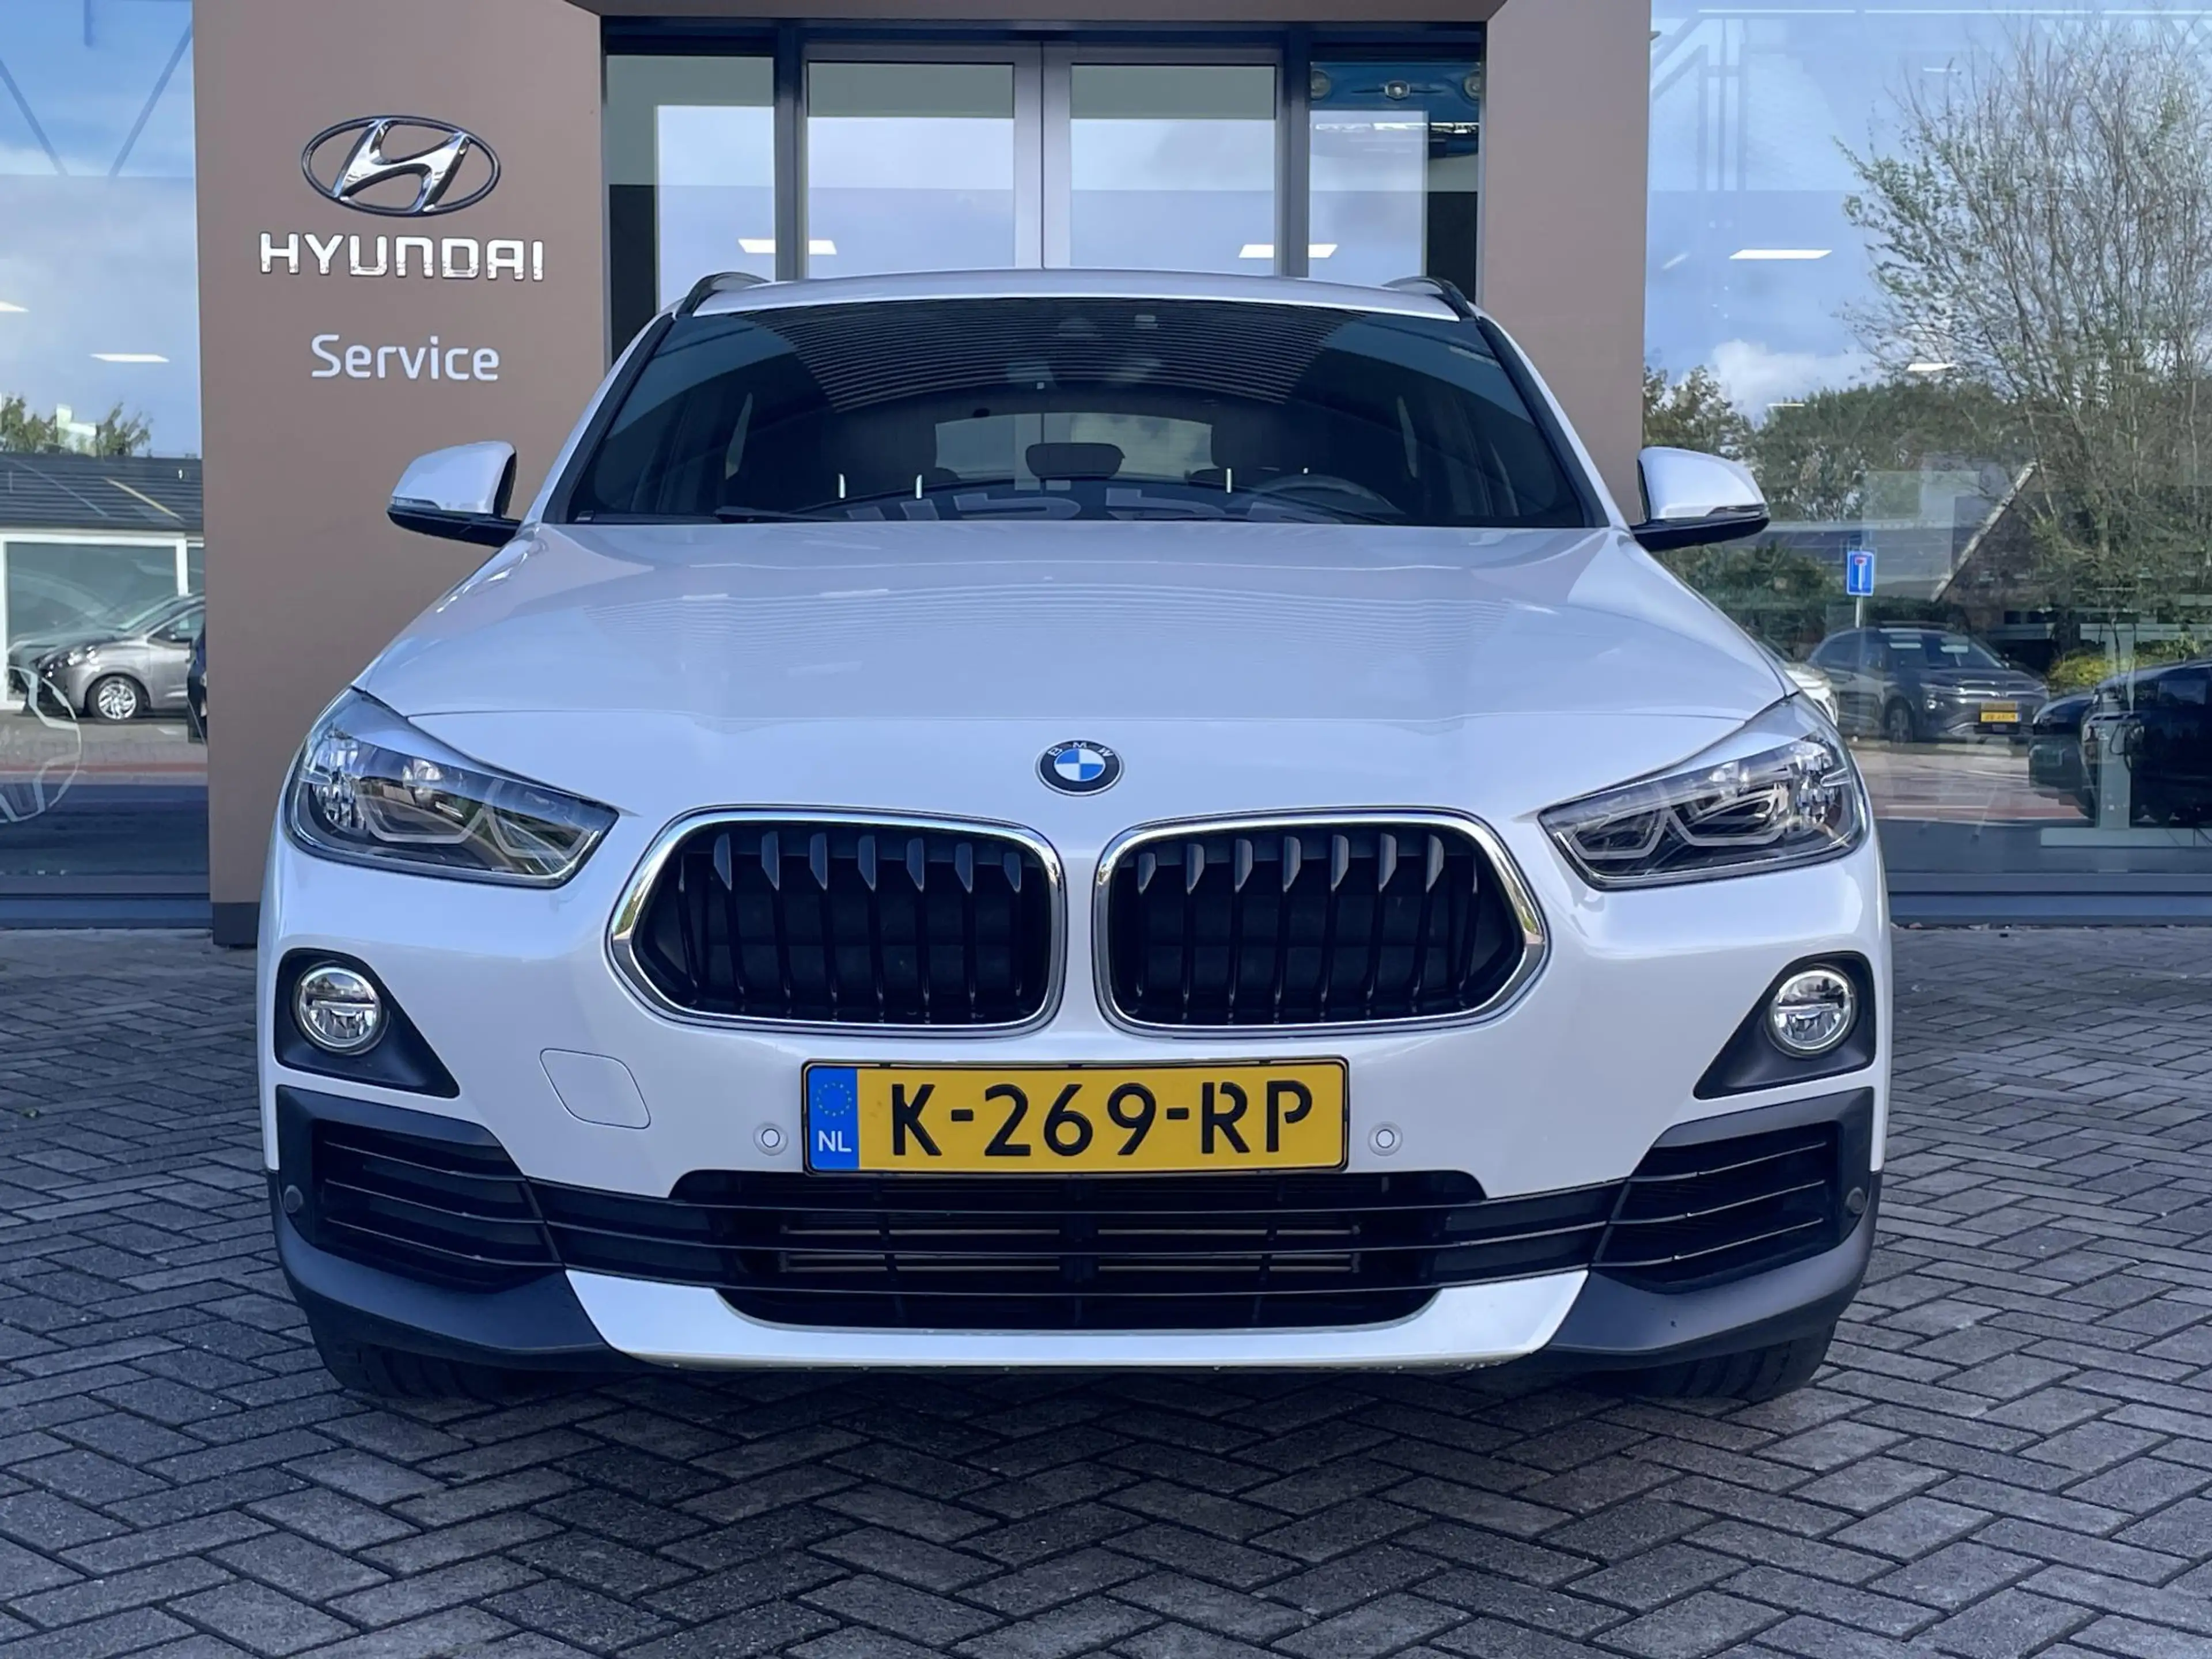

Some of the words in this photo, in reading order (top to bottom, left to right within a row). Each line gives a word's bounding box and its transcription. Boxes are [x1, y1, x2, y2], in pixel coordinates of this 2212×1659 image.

[260, 232, 544, 281] HYUNDAI
[310, 334, 500, 381] Service
[1047, 741, 1114, 757] BMW
[818, 1130, 853, 1152] NL
[891, 1080, 1313, 1156] K-269-RP
